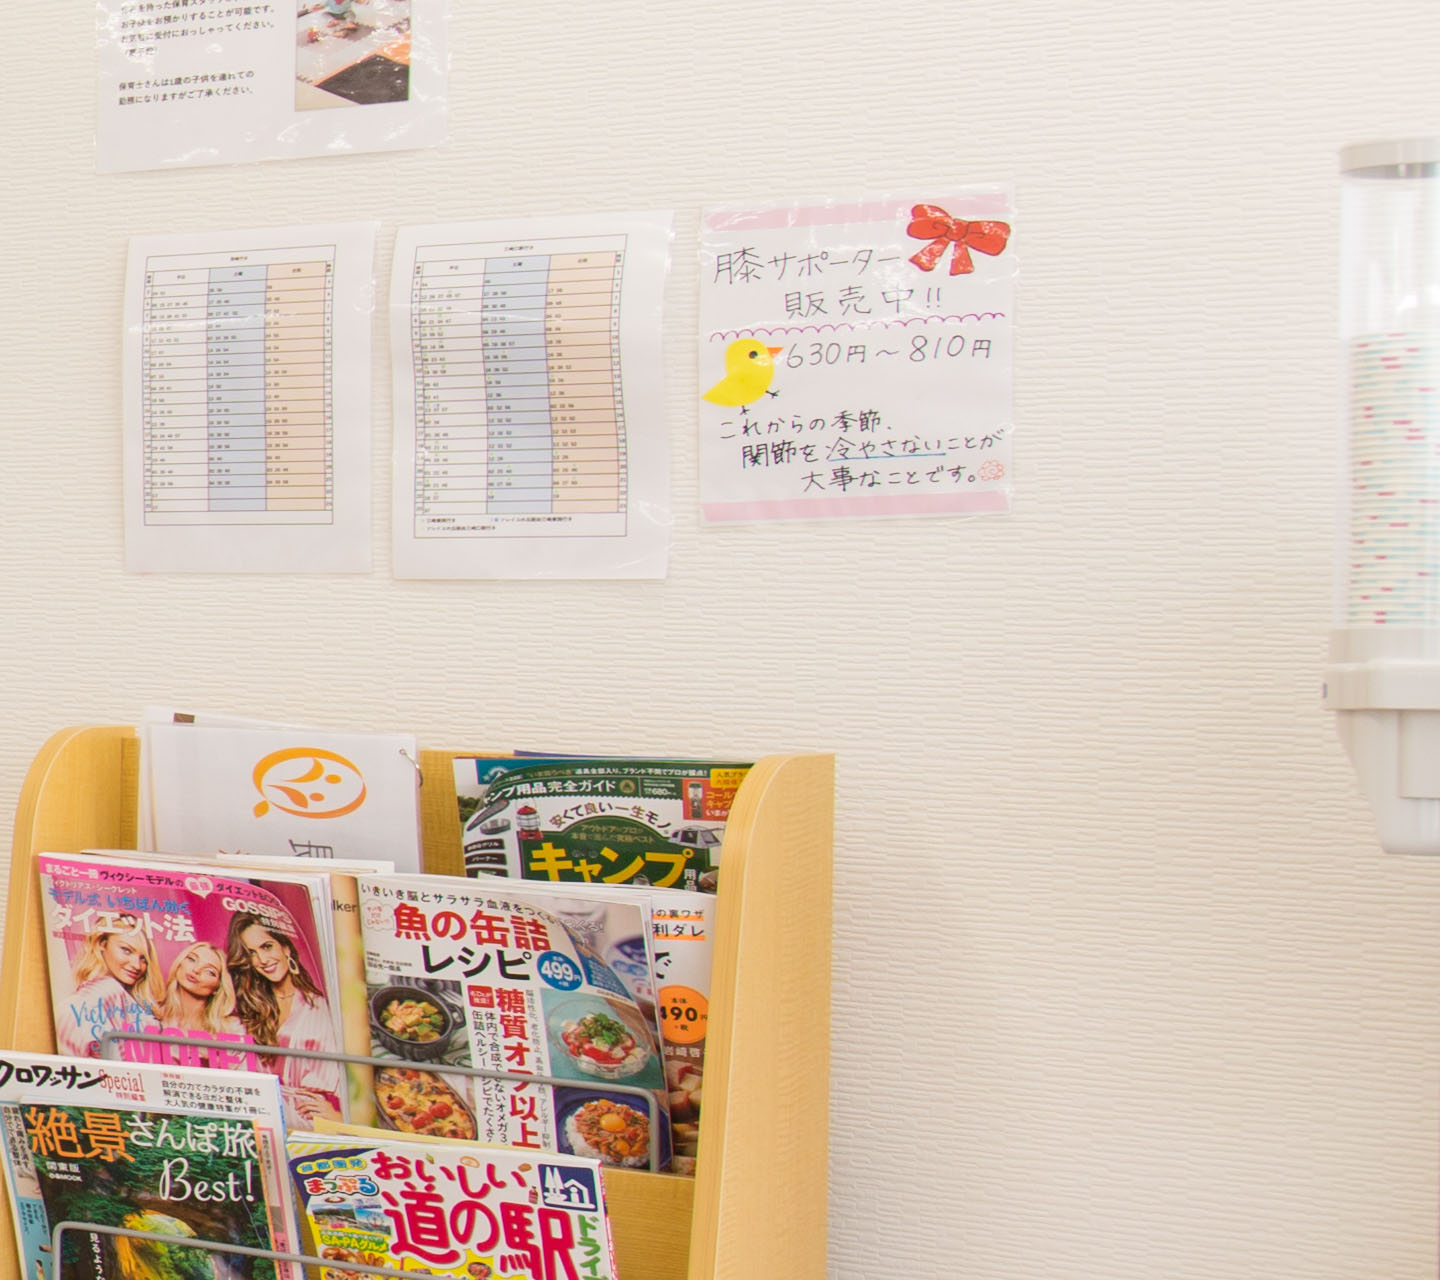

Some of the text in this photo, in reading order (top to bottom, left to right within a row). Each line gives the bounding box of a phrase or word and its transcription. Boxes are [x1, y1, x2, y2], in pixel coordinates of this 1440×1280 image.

[714, 246, 901, 284] 膝サポーター
[784, 285, 942, 319] 販売中!!
[742, 429, 1005, 470] 関節を冷やさないことが
[801, 464, 977, 493] 大事なことです。
[549, 801, 672, 830] 安くて良い一生モノ
[528, 841, 696, 888] キャンプ
[51, 903, 197, 943] ダイエット法
[393, 901, 553, 952] 魚の缶詰
[421, 944, 534, 981] レシピ
[495, 987, 542, 1149] 糖質オフ以上
[663, 1046, 709, 1059] 岩崎啓
[101, 1068, 148, 1094] Special
[161, 1079, 262, 1097] 自分の力でカラダの不調を
[26, 1106, 259, 1163] 絶景さんぽ旅
[159, 1156, 255, 1202] Best!
[306, 1176, 377, 1194] まっぷる
[370, 1151, 529, 1199] おいしい
